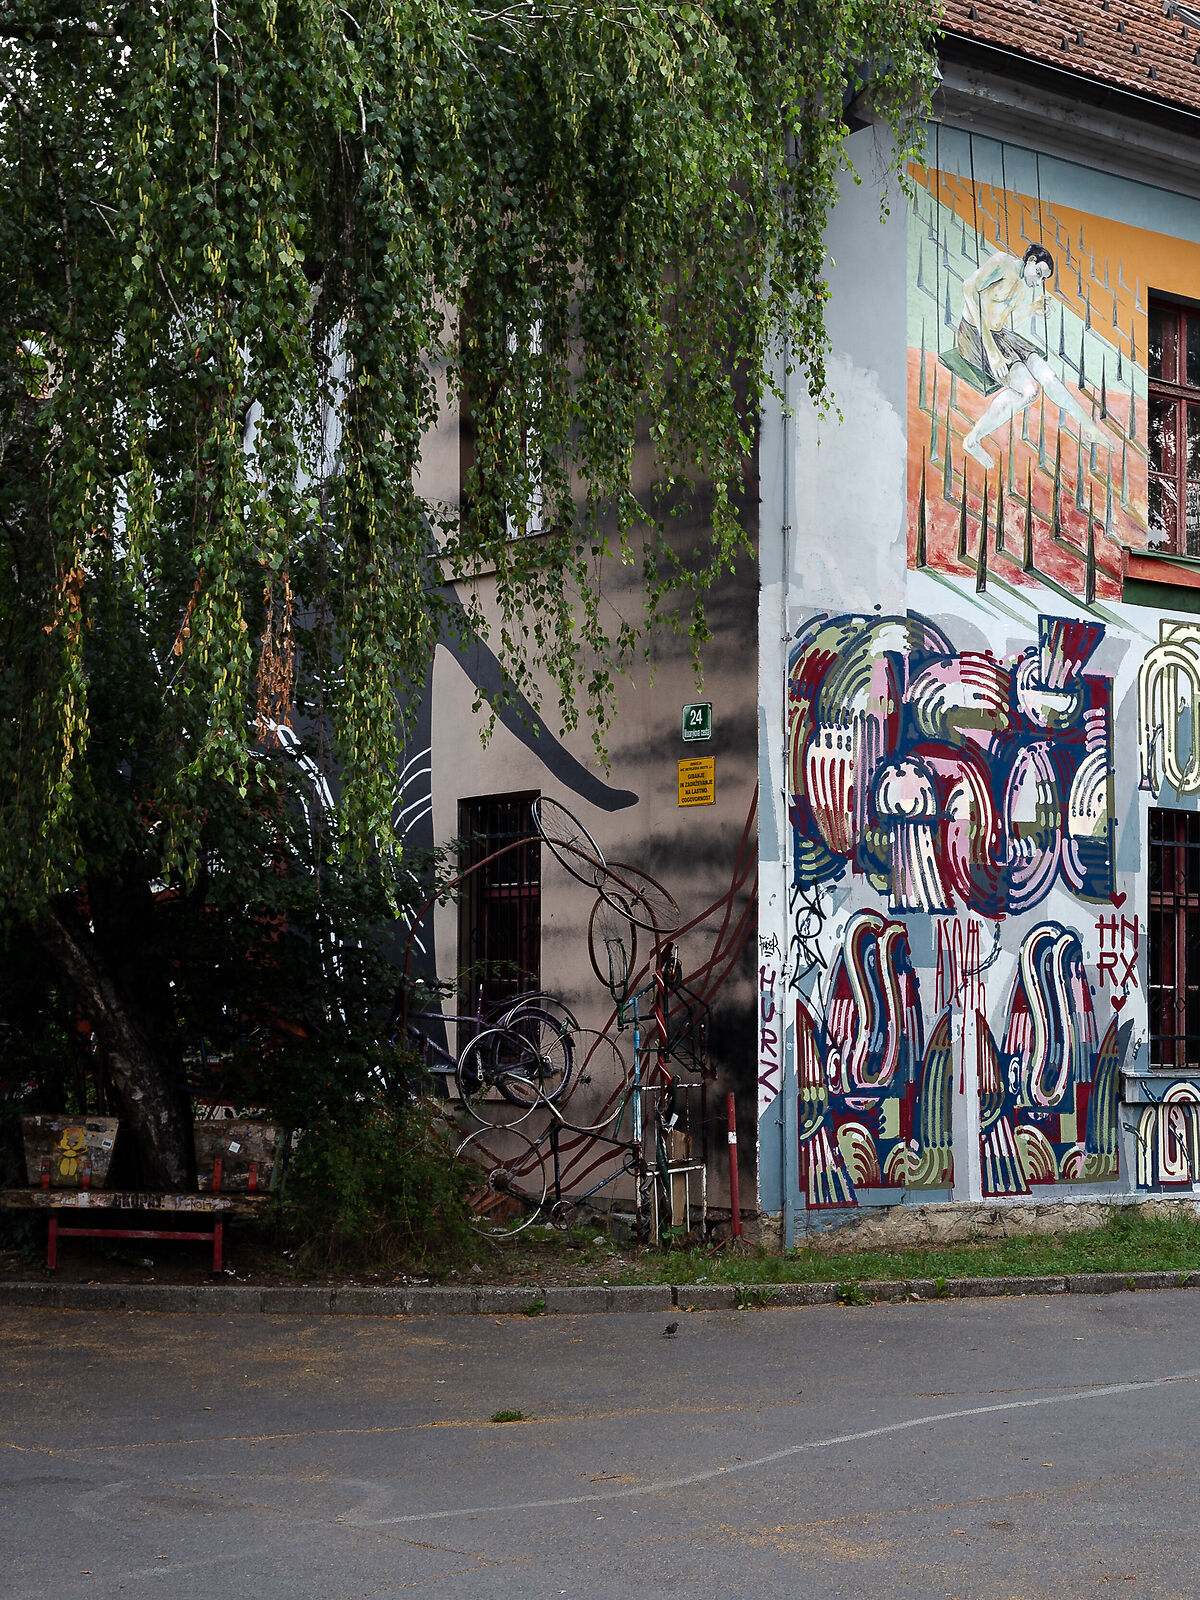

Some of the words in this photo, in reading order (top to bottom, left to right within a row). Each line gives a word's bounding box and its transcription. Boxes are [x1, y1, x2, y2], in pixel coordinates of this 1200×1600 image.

[690, 709, 703, 725] 24
[1095, 914, 1139, 950] HN
[1097, 951, 1139, 988] RX
